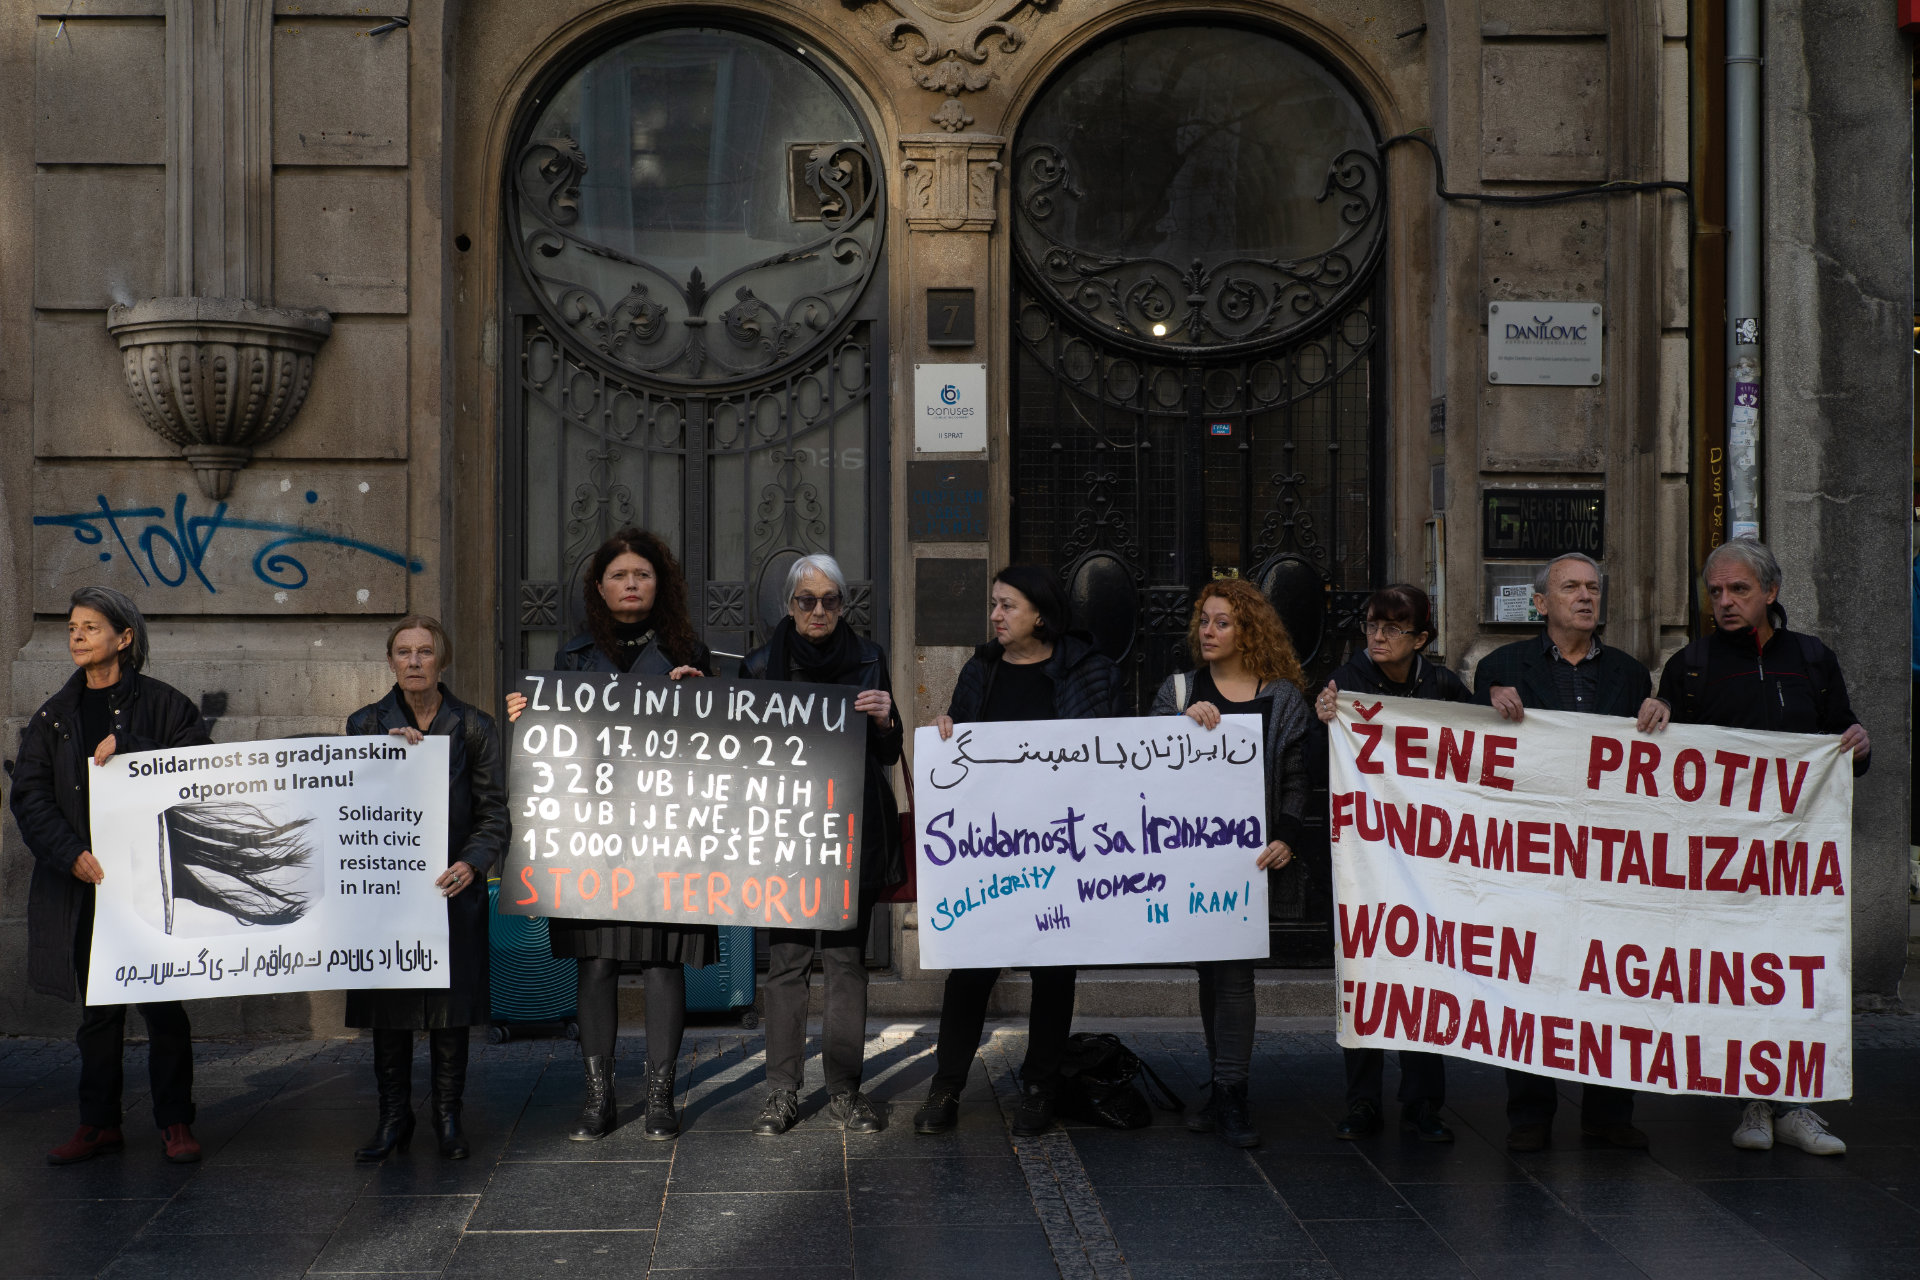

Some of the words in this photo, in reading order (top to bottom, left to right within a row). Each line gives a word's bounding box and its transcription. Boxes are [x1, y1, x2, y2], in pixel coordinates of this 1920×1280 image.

[944, 305, 960, 335] 7
[927, 406, 974, 416] bonuses
[1520, 497, 1599, 520] NEKRETNINE
[696, 691, 712, 718] U
[522, 724, 578, 758] OD
[128, 749, 242, 777] Solidarnost
[247, 752, 270, 766] sa
[275, 743, 406, 768] gradjanskim
[1352, 701, 1516, 791] ŽENE
[1587, 736, 1809, 813] PROTIV
[179, 780, 267, 802] otporom
[273, 777, 287, 791] u
[293, 771, 353, 789] Iranu!
[532, 761, 613, 794] 328
[339, 805, 423, 826] Solidarity
[523, 797, 561, 820] 50
[339, 830, 378, 845] with
[383, 831, 420, 846] civic
[924, 807, 1086, 866] Solidarnost
[1093, 822, 1136, 855] sa
[1332, 791, 1844, 896] FUNDAMENTALIZAMA
[341, 855, 426, 871] resistance
[341, 880, 357, 894] in
[363, 880, 400, 895] Iran!
[516, 866, 635, 910] STOP
[657, 871, 821, 923] TERORU
[1035, 904, 1070, 931] with
[1339, 903, 1536, 985] WOMEN
[1579, 940, 1824, 1008] AGAINST
